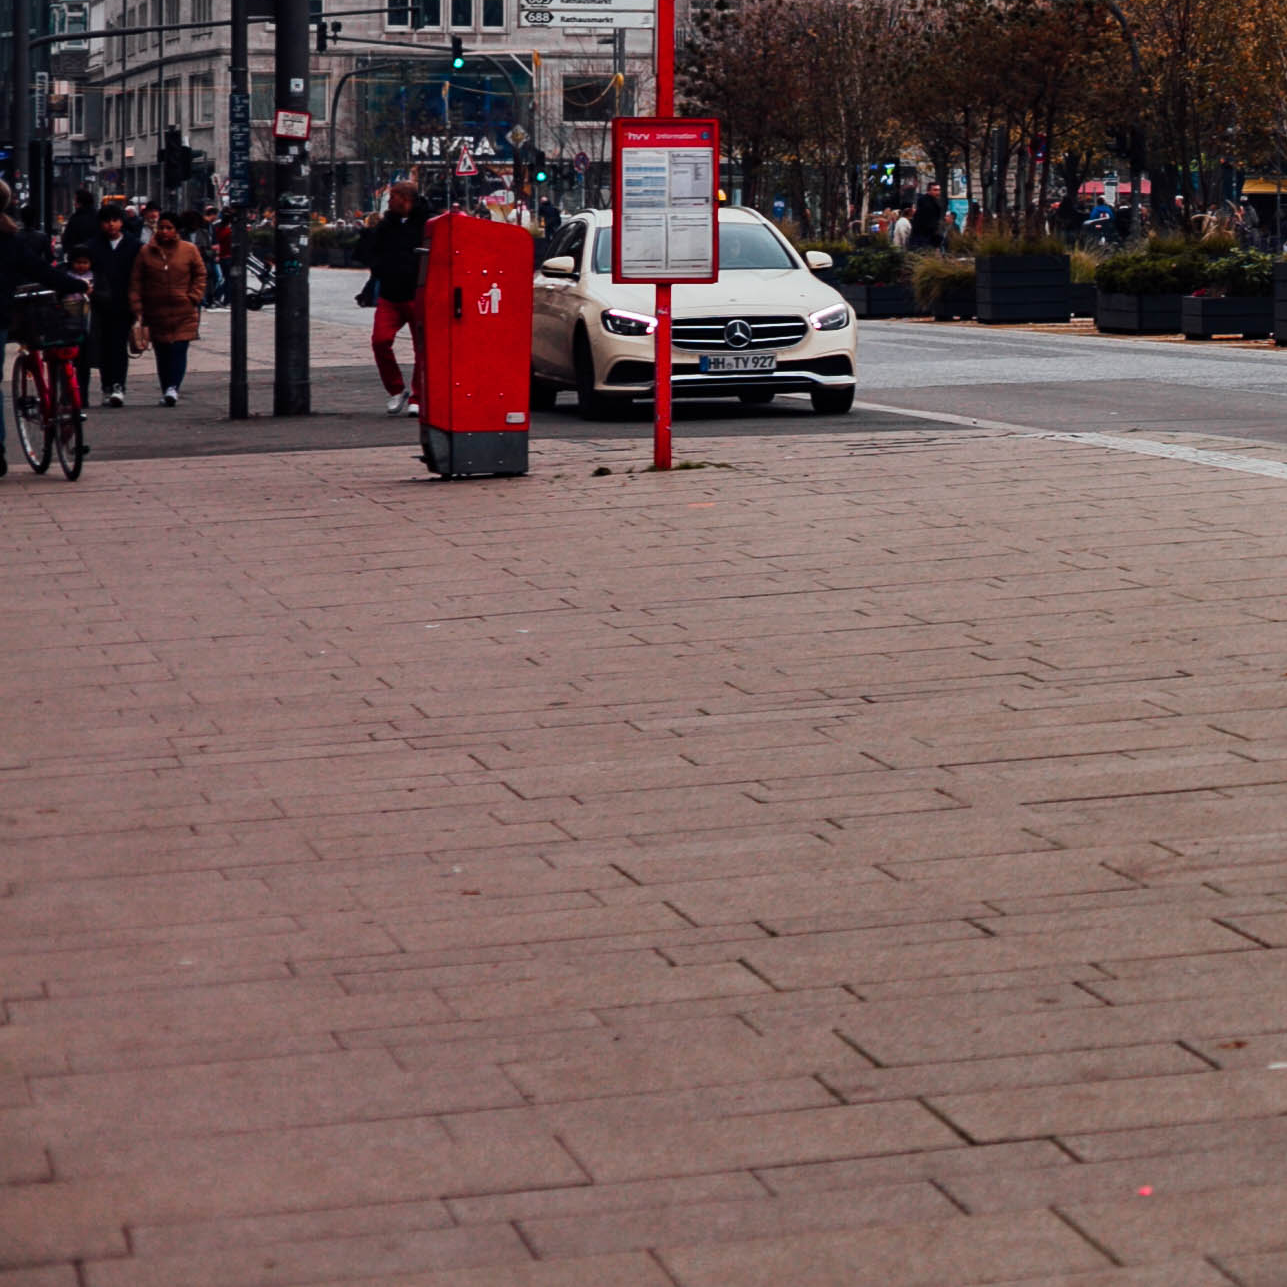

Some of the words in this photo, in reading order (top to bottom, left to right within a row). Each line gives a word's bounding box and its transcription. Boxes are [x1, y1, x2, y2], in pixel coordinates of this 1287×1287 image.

[528, 12, 550, 22] 688
[560, 16, 613, 24] Rathausmarkt
[708, 357, 726, 370] HH
[733, 356, 750, 369] TY
[751, 355, 775, 368] 927
